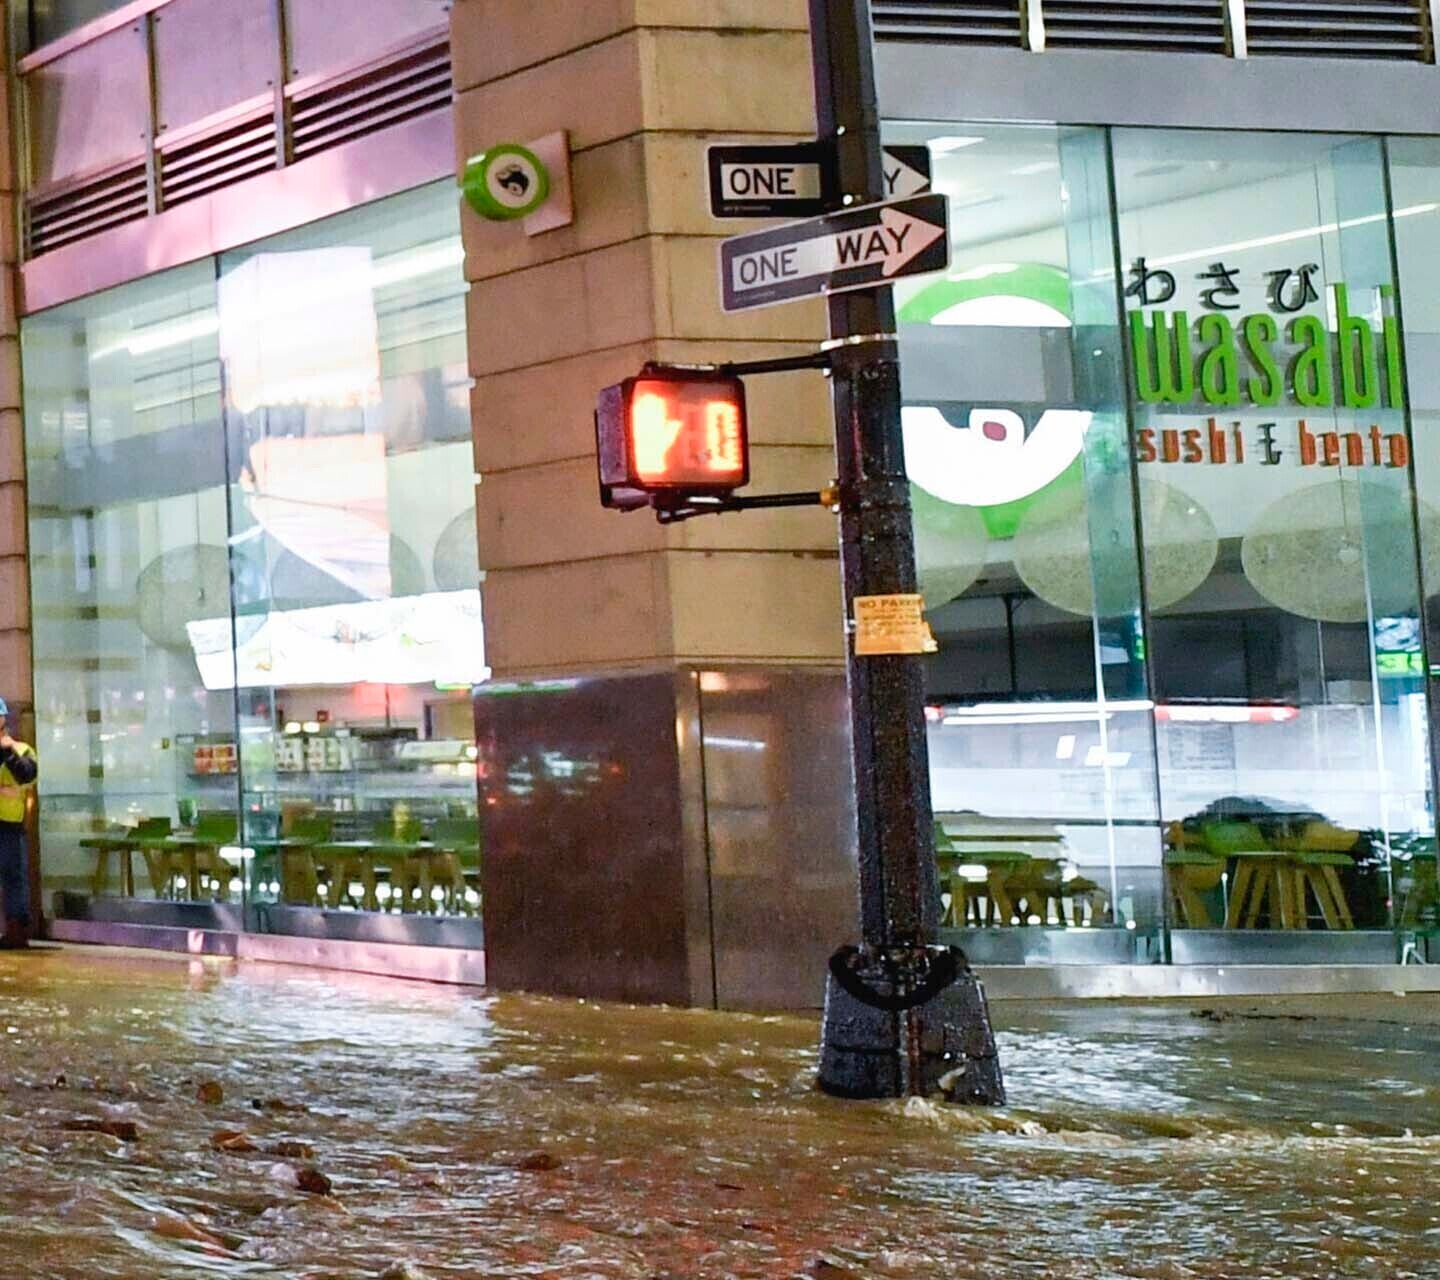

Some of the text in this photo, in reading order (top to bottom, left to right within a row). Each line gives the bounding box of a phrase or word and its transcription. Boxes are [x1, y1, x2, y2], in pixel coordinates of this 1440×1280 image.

[730, 168, 796, 196] ONE
[740, 223, 912, 285] ONE WAY
[1125, 257, 1319, 312] わさび
[1128, 283, 1403, 408] wasabi
[1136, 417, 1245, 464] sushi
[1298, 420, 1409, 467] bento
